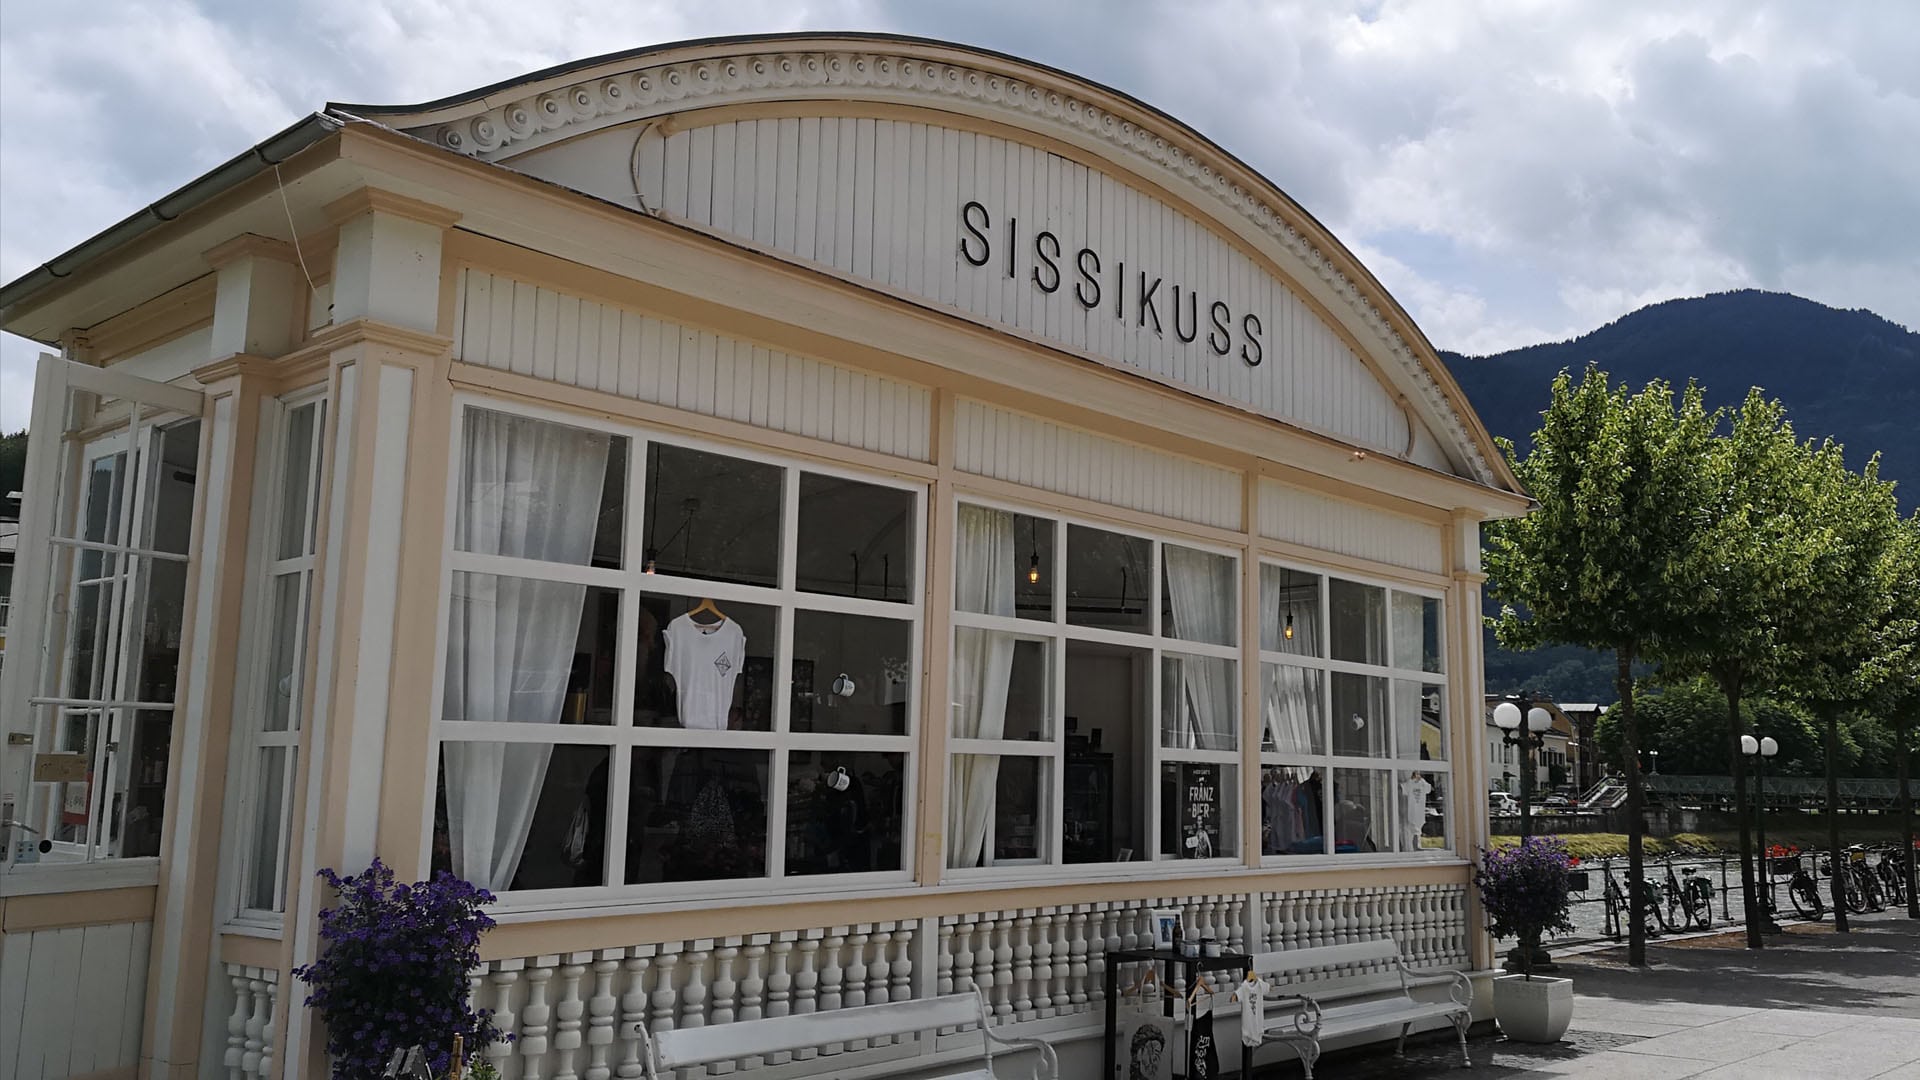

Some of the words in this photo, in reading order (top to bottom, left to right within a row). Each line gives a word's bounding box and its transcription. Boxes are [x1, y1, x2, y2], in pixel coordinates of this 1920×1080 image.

[961, 202, 1263, 366] SISSIKUSS
[1189, 787, 1214, 802] FRANZ
[1191, 803, 1210, 818] BIER
